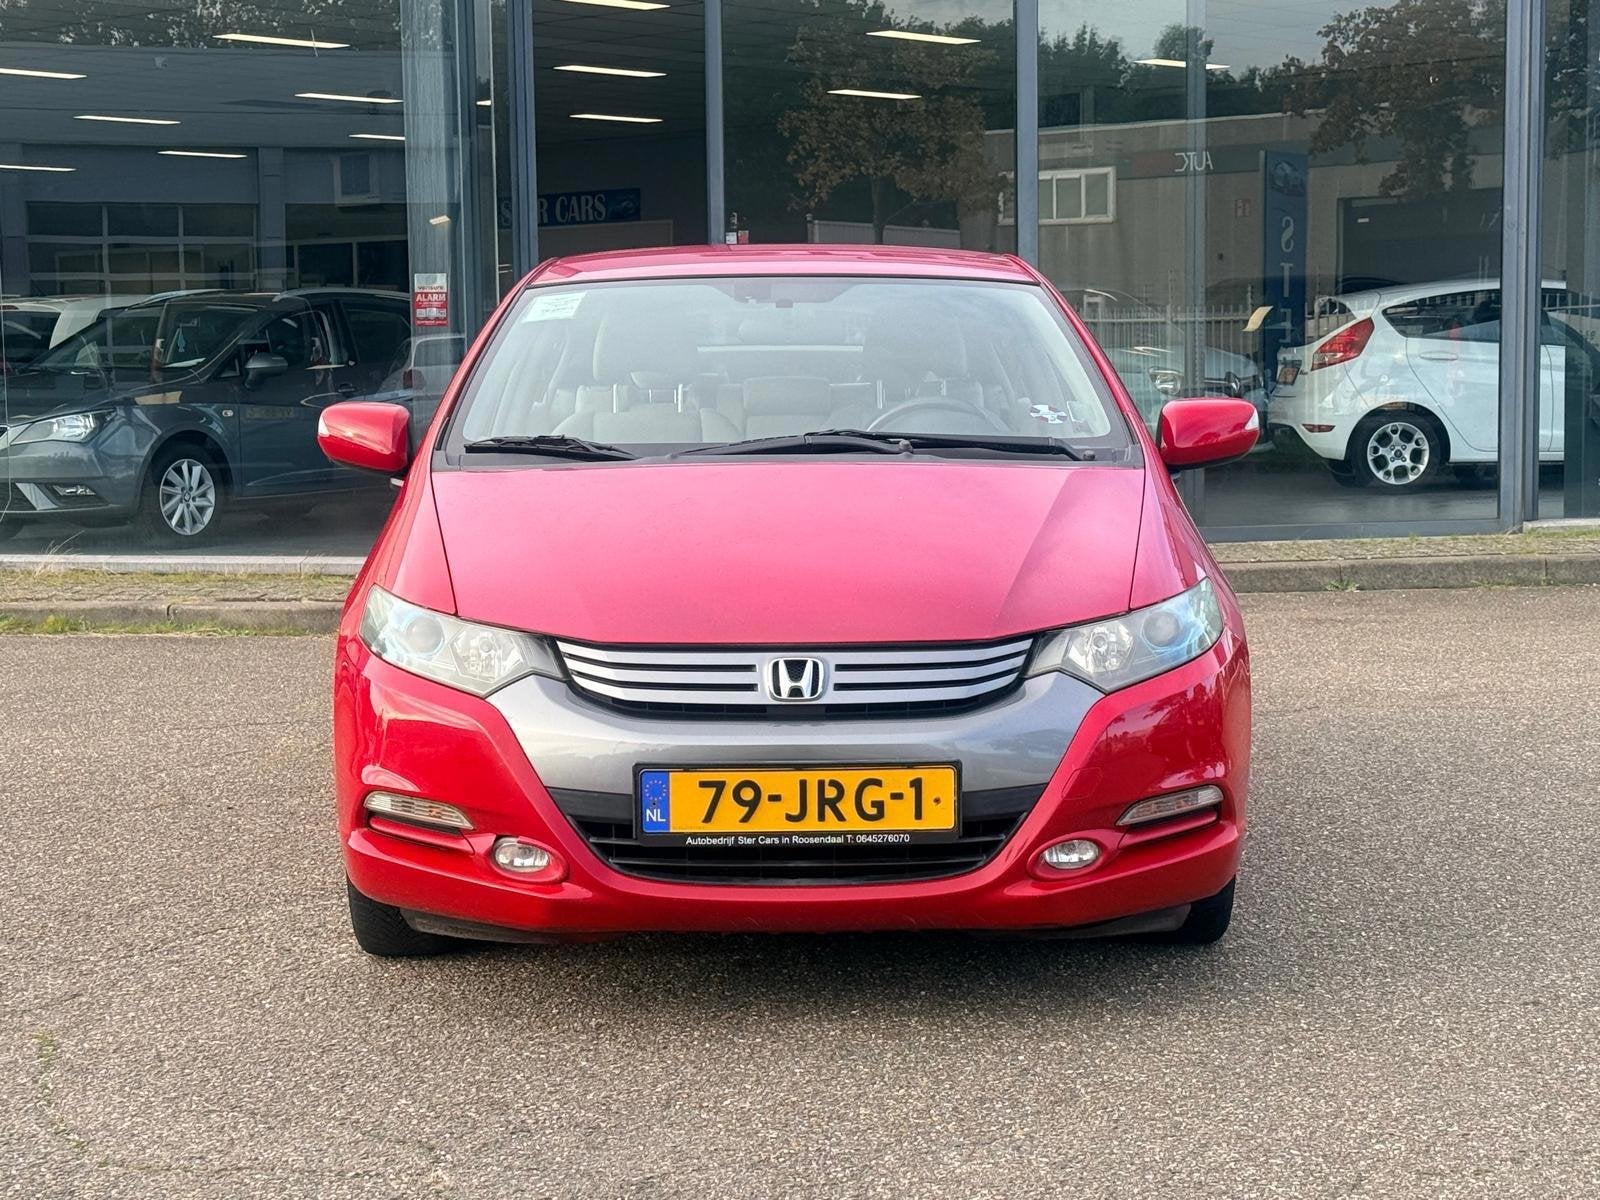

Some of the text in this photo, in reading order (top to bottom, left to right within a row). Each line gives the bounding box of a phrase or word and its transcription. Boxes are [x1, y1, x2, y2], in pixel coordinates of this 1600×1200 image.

[555, 194, 606, 223] CARS
[416, 293, 446, 302] ALARM
[698, 777, 924, 823] 79-JRG-1
[645, 809, 667, 822] NL
[685, 834, 910, 846] Autobedrijf Ster Cars in Roosendaal T: 0645276070
